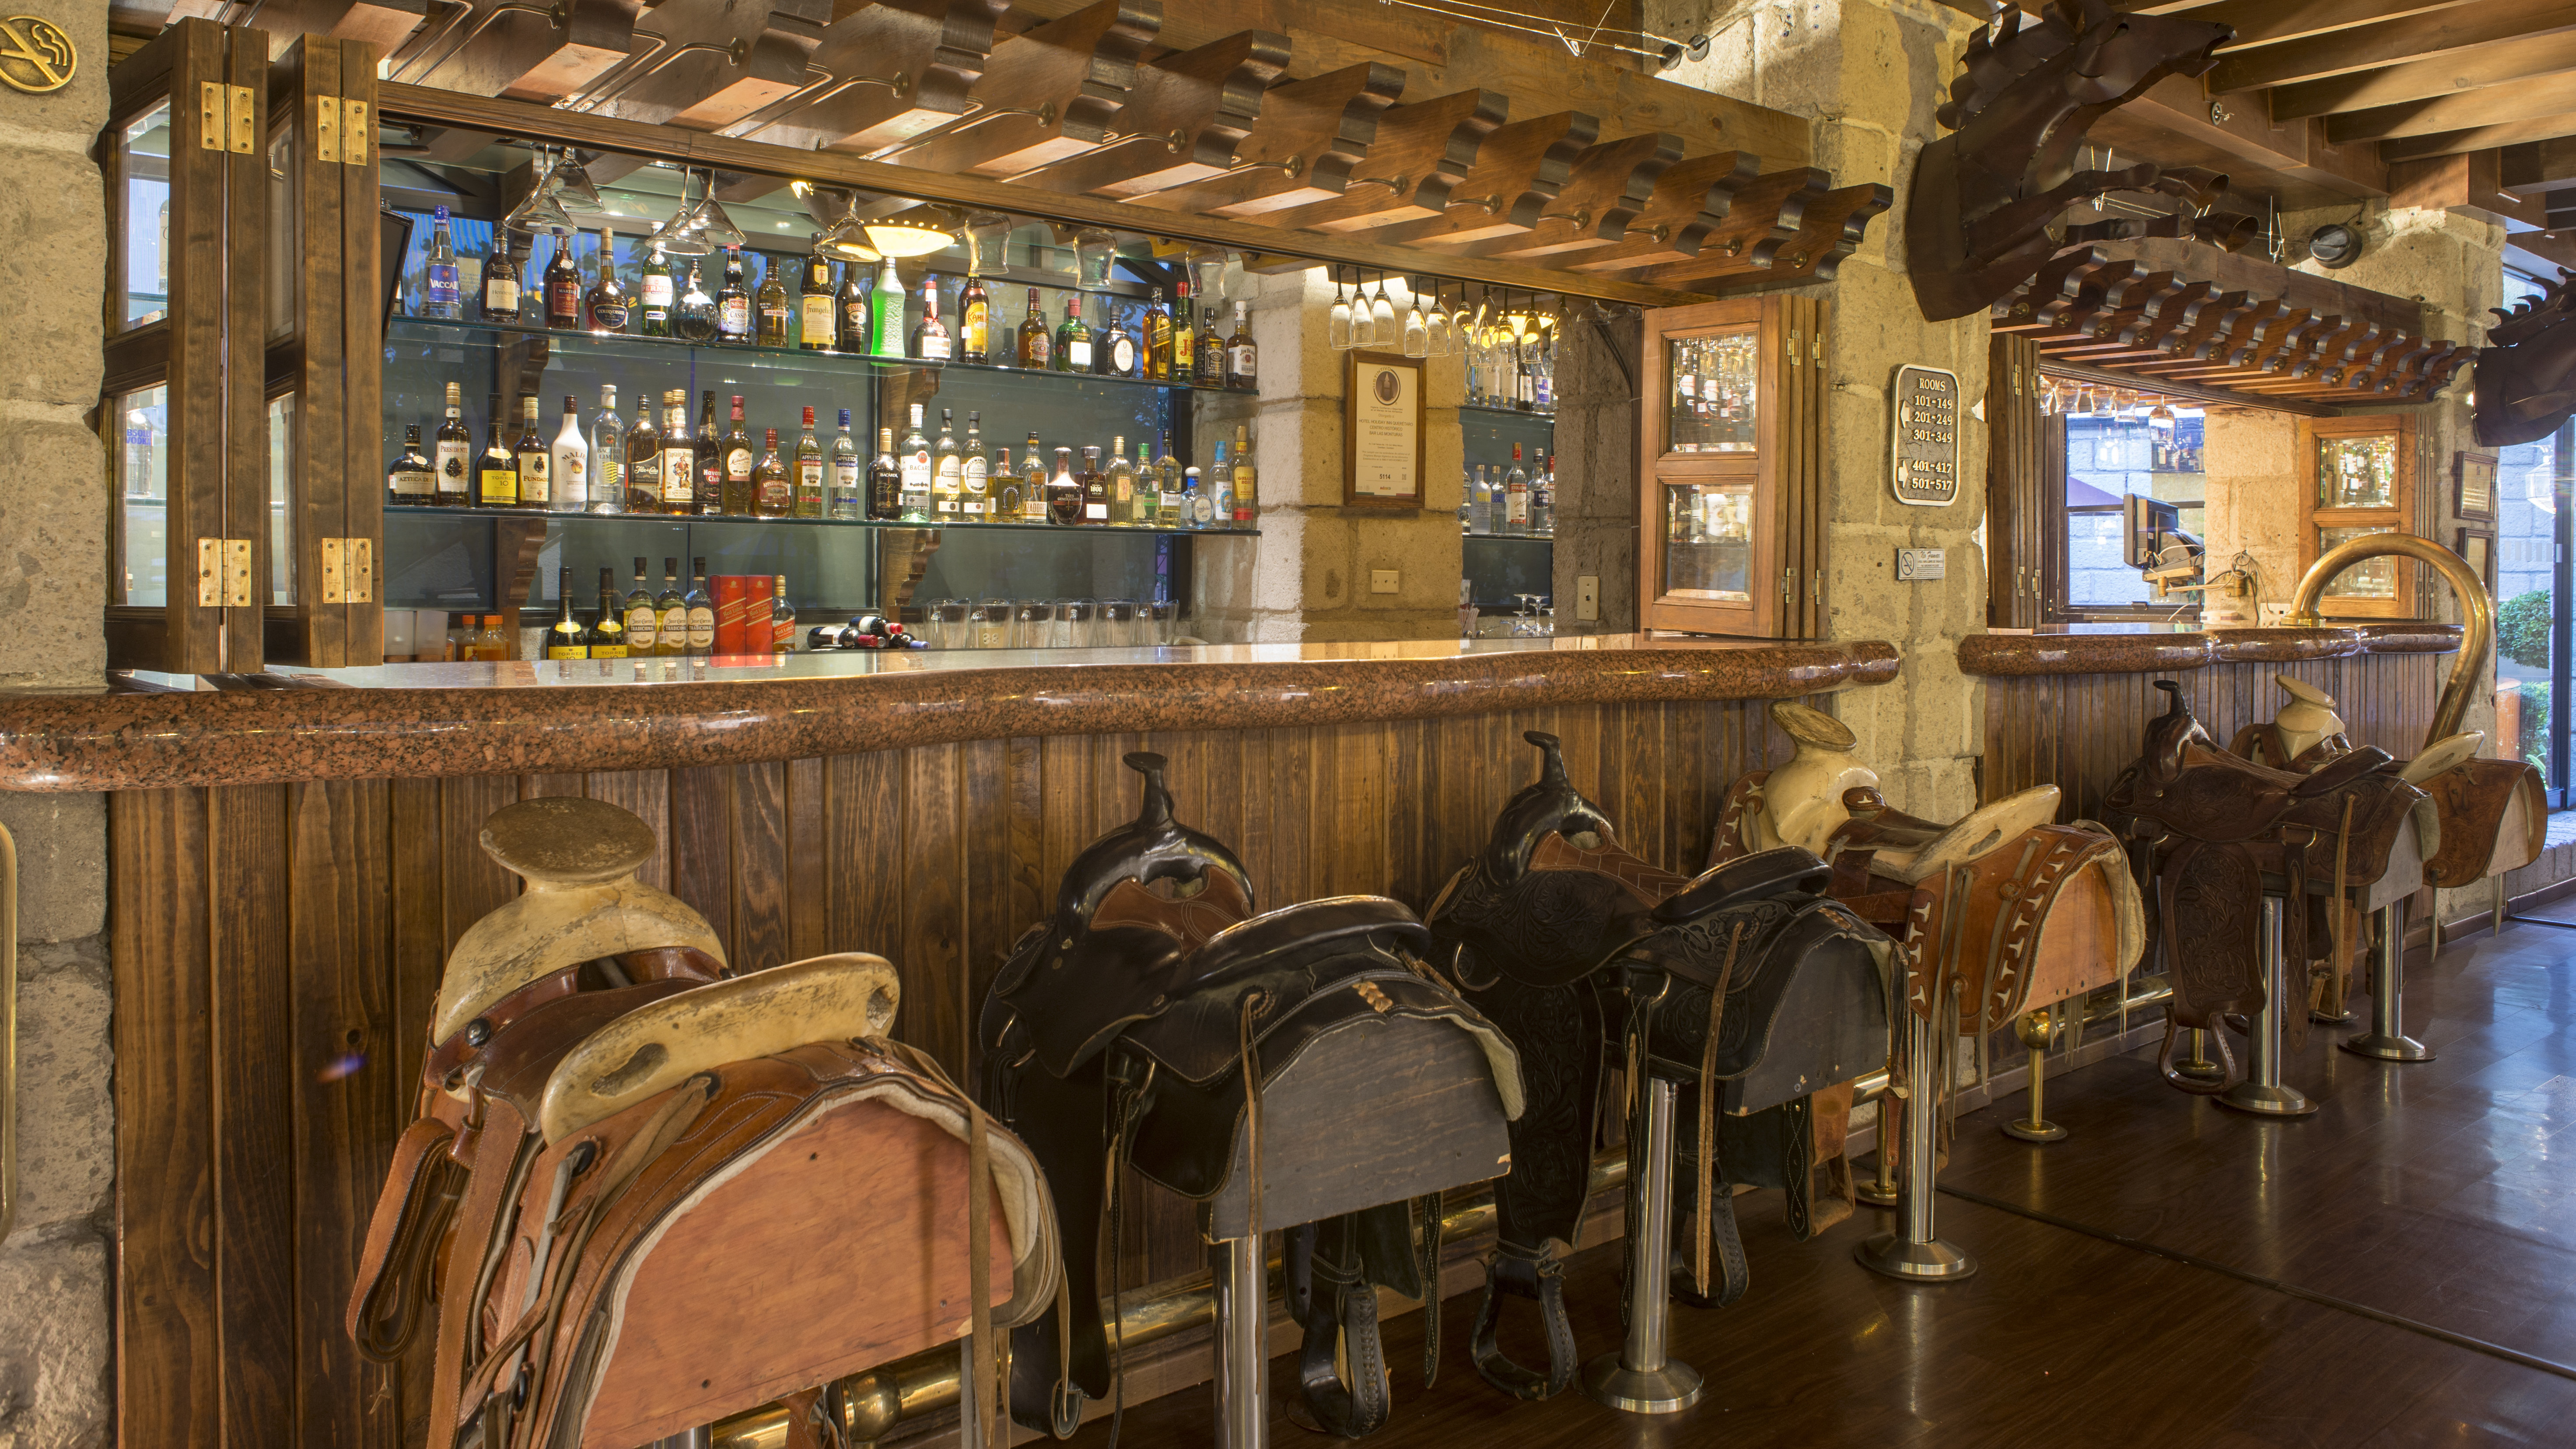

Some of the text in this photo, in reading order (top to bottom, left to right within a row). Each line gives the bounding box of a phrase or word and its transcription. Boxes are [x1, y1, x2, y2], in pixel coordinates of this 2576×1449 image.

[642, 285, 672, 294] PERNOD
[1372, 367, 1391, 390] DISTINTIVO
[1919, 378, 1946, 392] ROOMS
[1914, 395, 1953, 410] 101-149
[1914, 411, 1953, 426] 201-249
[1913, 429, 1953, 443] 301-349
[1912, 460, 1952, 473] 401-417
[1912, 477, 1953, 490] 501-517
